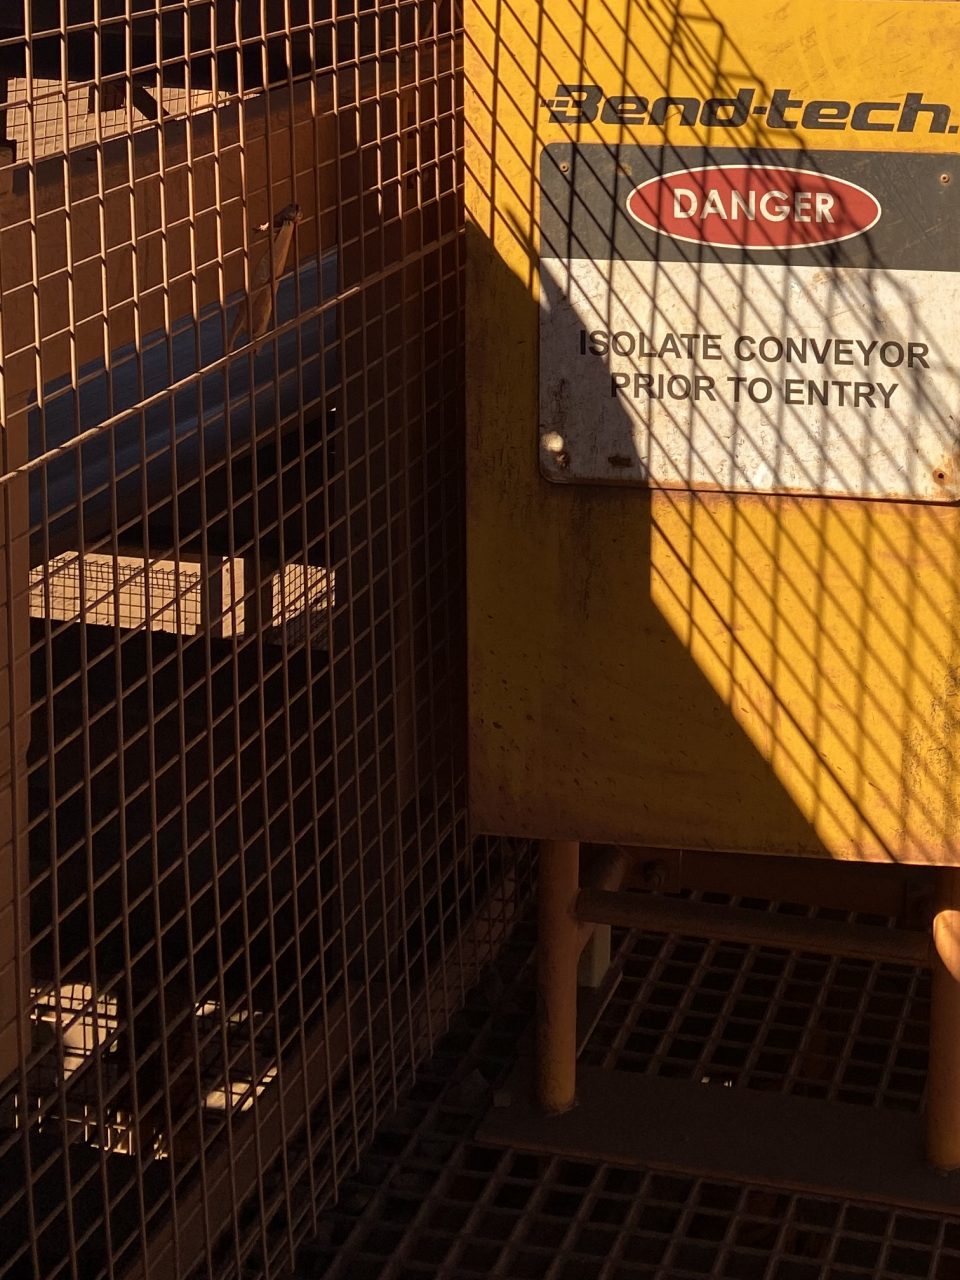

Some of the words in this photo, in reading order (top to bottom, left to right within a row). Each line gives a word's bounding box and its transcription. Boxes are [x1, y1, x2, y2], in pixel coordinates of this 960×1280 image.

[673, 188, 835, 224] DANGER
[579, 330, 722, 361] ISOLATE
[733, 335, 930, 368] CONVEYOR
[611, 373, 715, 402] PRIOR
[727, 376, 772, 405] TO
[784, 379, 899, 410] ENTRY
